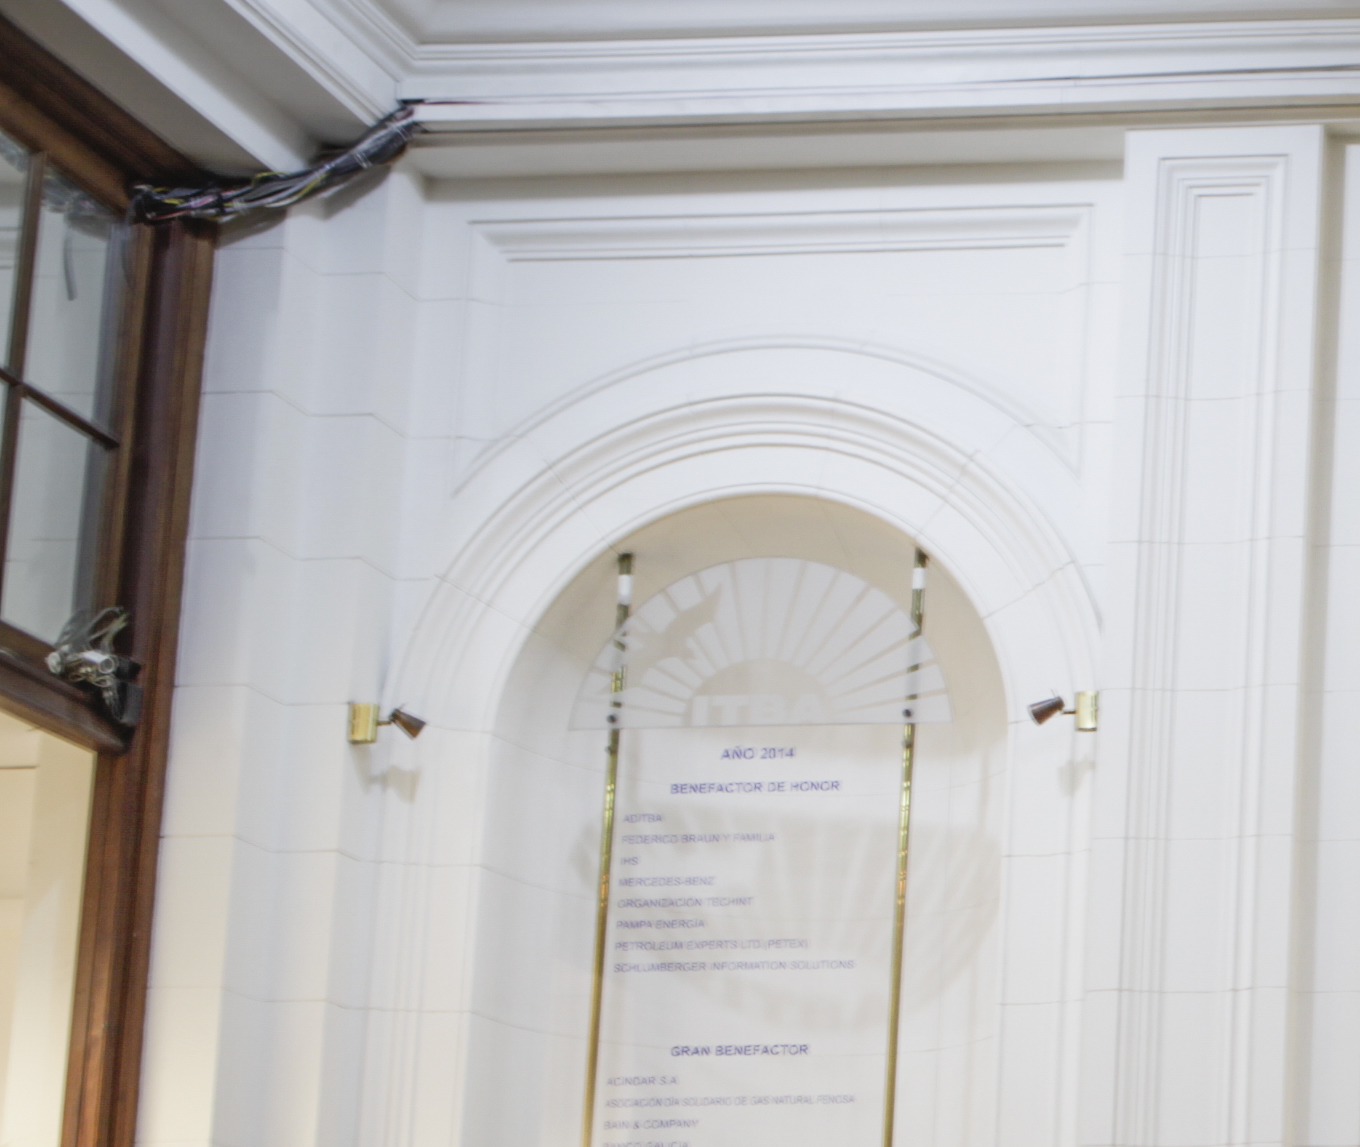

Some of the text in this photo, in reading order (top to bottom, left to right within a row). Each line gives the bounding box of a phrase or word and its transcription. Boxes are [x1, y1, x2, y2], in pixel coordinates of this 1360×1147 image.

[720, 746, 797, 760] AÑO 2014
[670, 780, 842, 795] BENEFACTOR DE HONOR
[622, 834, 678, 845] FEDERICO
[681, 834, 720, 844] BRAUN
[733, 833, 776, 843] FAMILIA
[621, 856, 639, 866] IHS
[618, 875, 716, 888] MERCEDES-BENZ
[706, 896, 755, 907] TECHINT
[616, 920, 654, 930] PAMPA
[615, 941, 684, 952] PETROLEUM
[686, 940, 737, 950] EXPERTS
[613, 959, 856, 973] SCHLUMBERGER INFORMATION SOLUTIONS
[671, 1043, 810, 1057] GRAN BENEFACTOR
[606, 1076, 656, 1087] ACINDAR
[682, 1096, 732, 1107] SOLIDARIO
[735, 1096, 749, 1105] DE
[750, 1096, 770, 1105] GAS
[771, 1095, 815, 1105] NATURAL
[604, 1119, 699, 1131] BAIN & COMPANY
